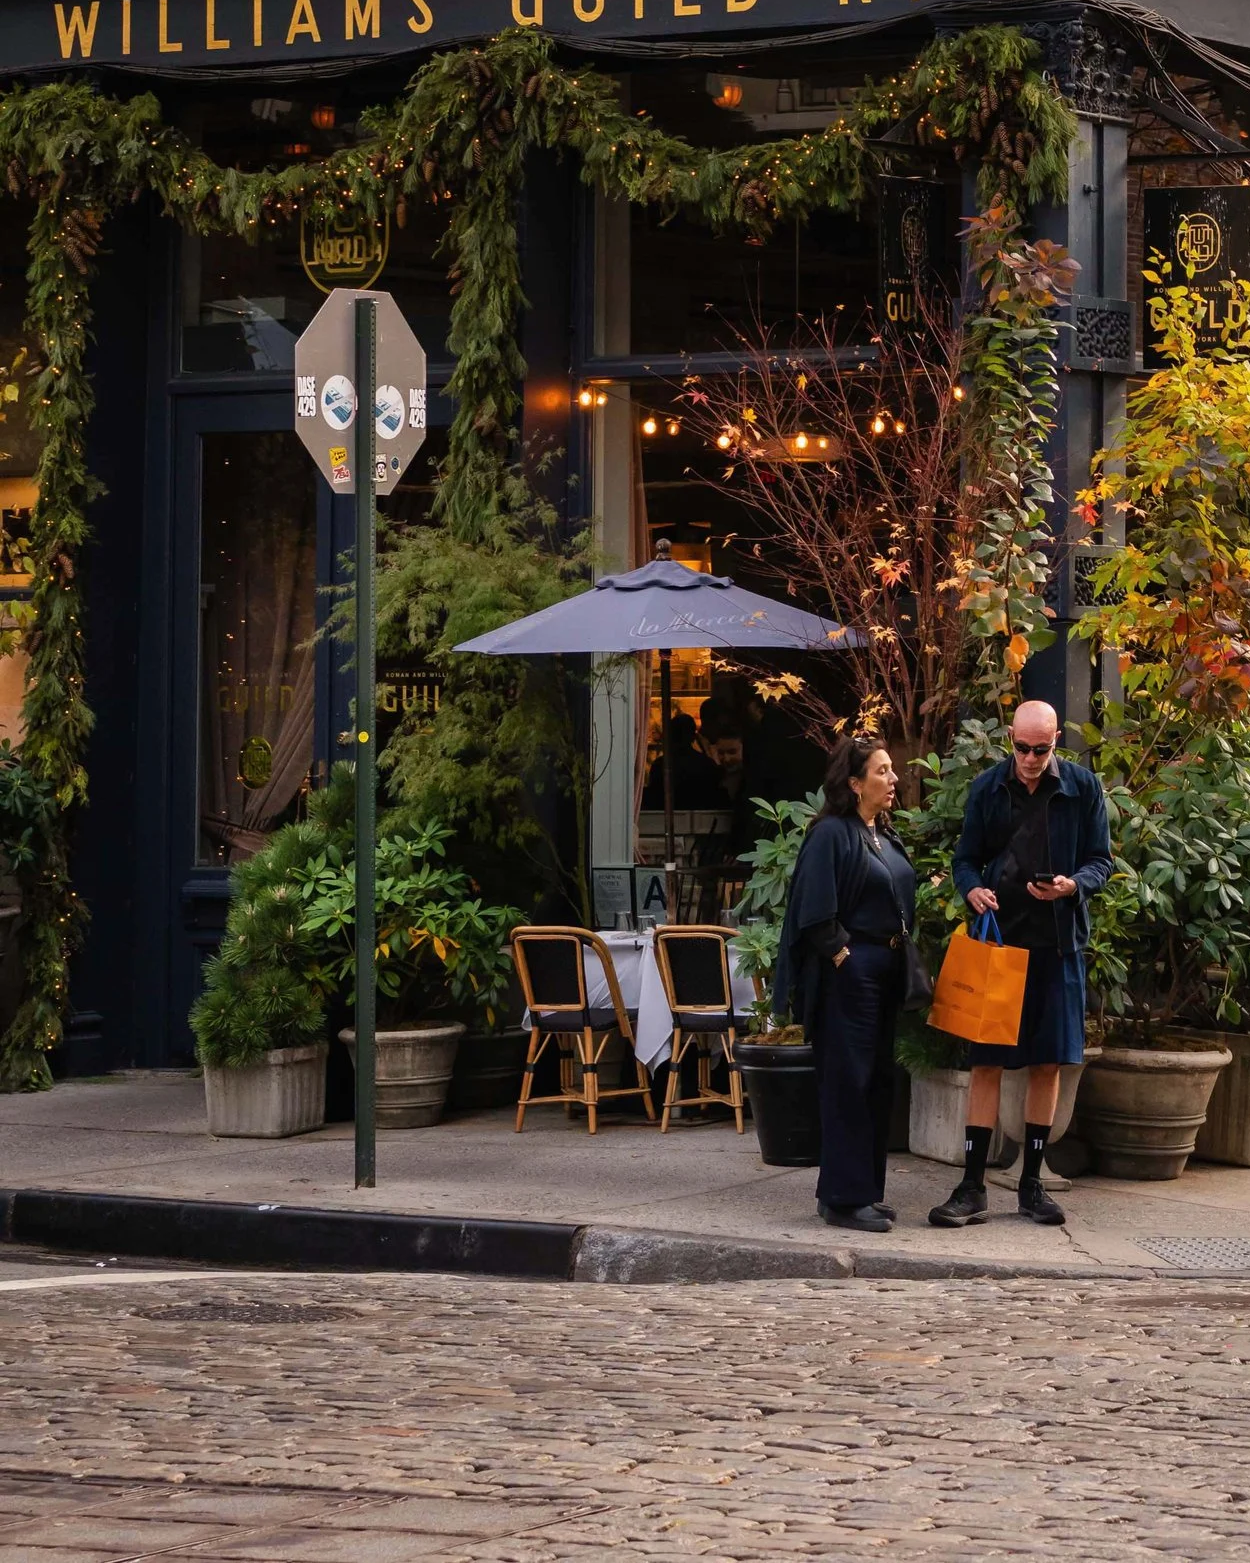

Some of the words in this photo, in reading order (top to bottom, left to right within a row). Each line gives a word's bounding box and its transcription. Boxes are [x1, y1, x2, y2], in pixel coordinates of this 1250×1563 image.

[297, 376, 316, 396] DASE
[298, 396, 316, 417] 429
[409, 388, 426, 409] DASE
[409, 408, 426, 429] 429
[383, 685, 441, 713] GUIL
[642, 875, 667, 911] A
